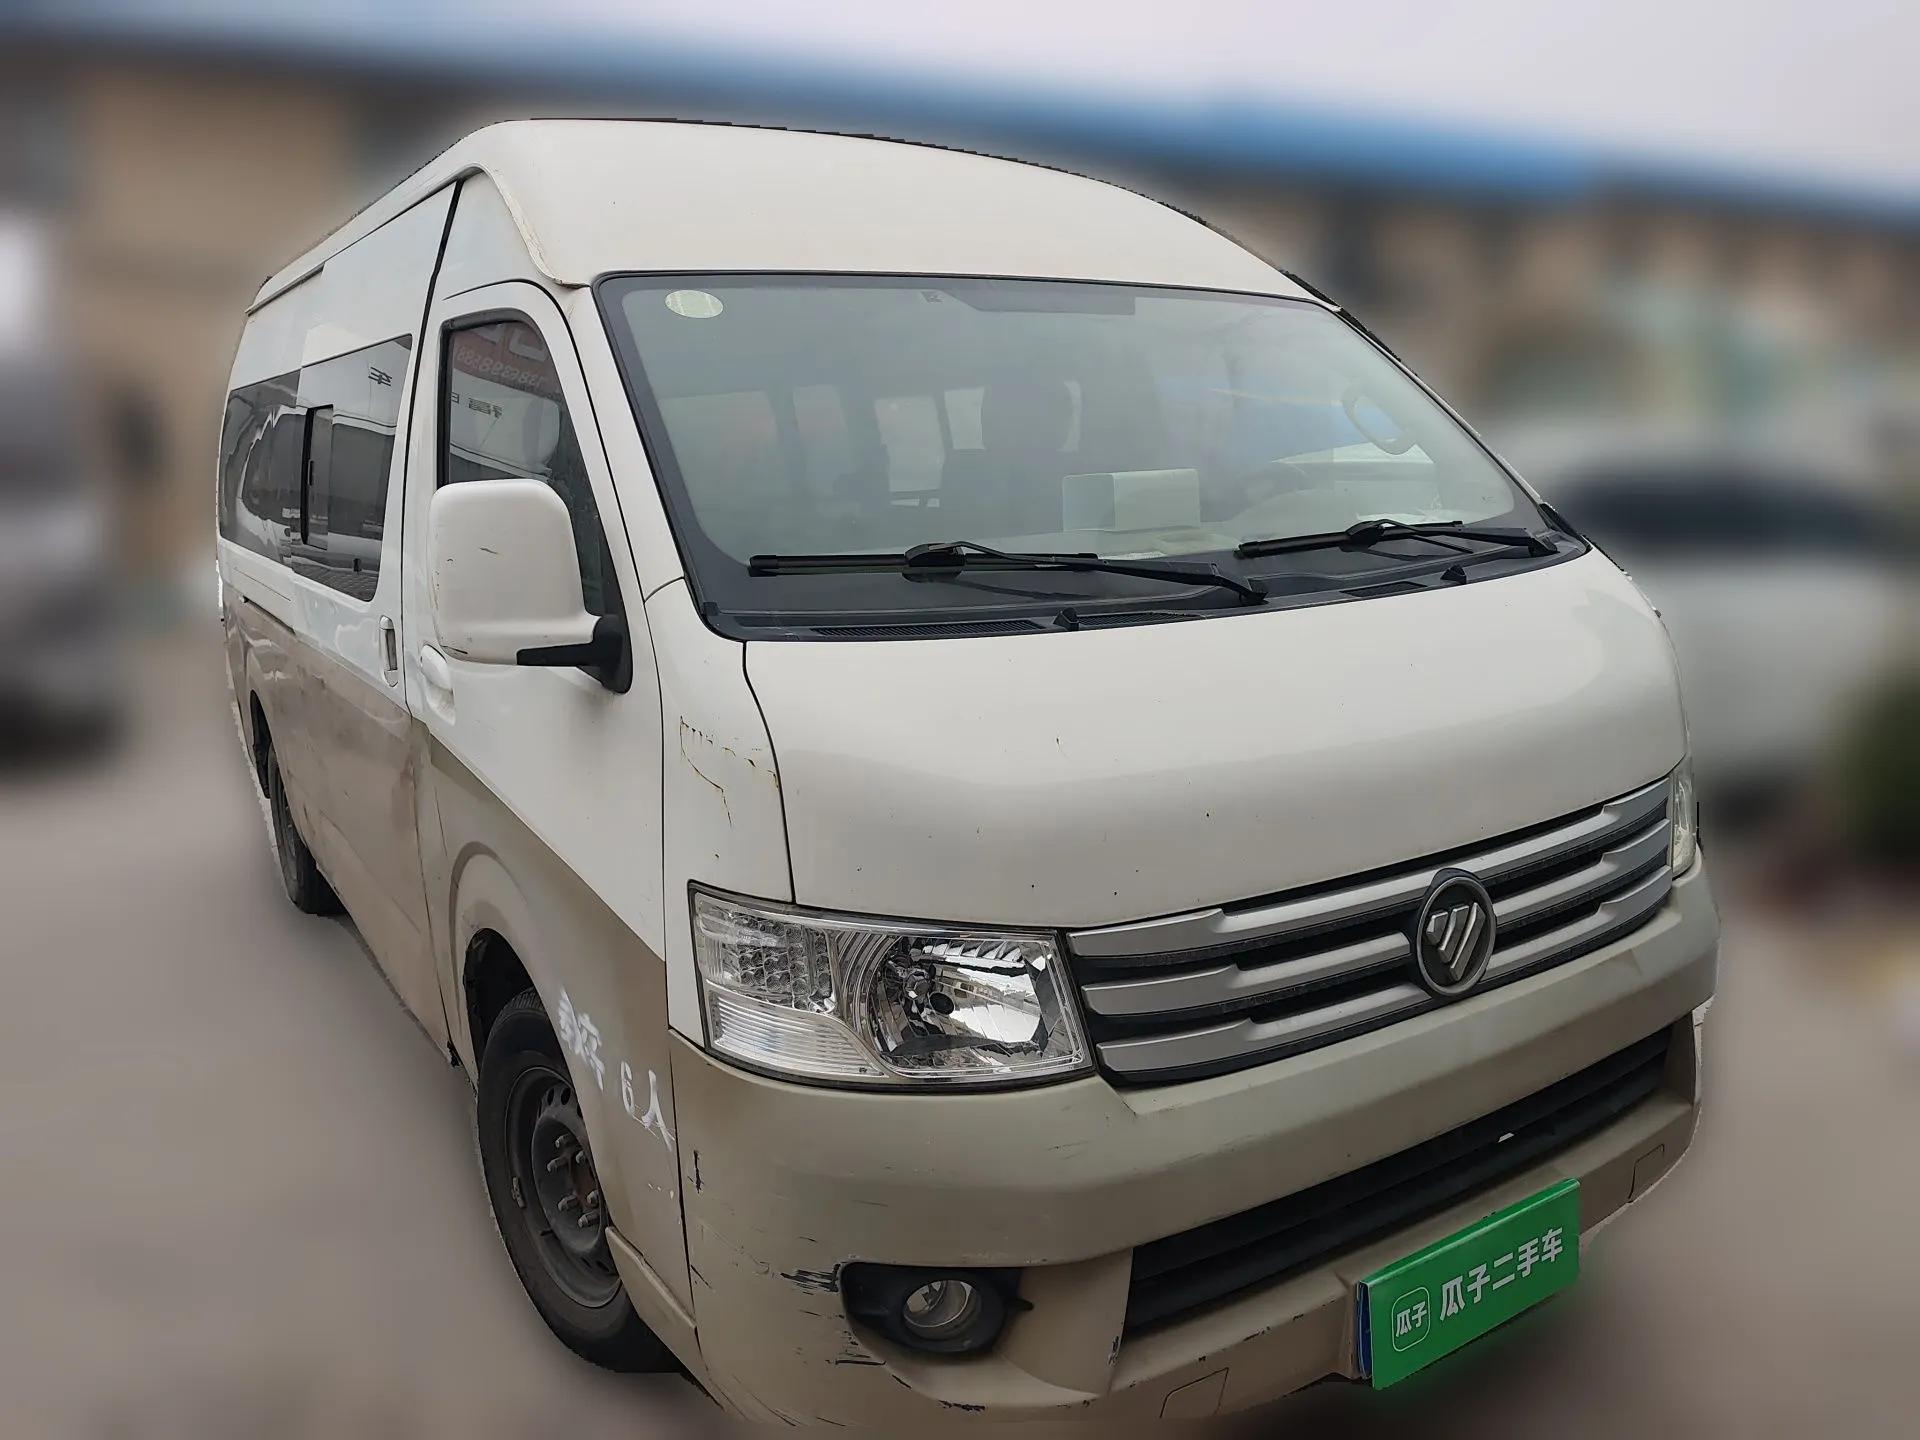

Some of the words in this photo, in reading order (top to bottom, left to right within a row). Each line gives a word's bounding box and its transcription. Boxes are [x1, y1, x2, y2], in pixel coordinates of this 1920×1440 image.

[620, 1060, 673, 1152] 6人
[1395, 1301, 1428, 1338] 瓜子
[1439, 1226, 1564, 1322] 瓜子二手车
